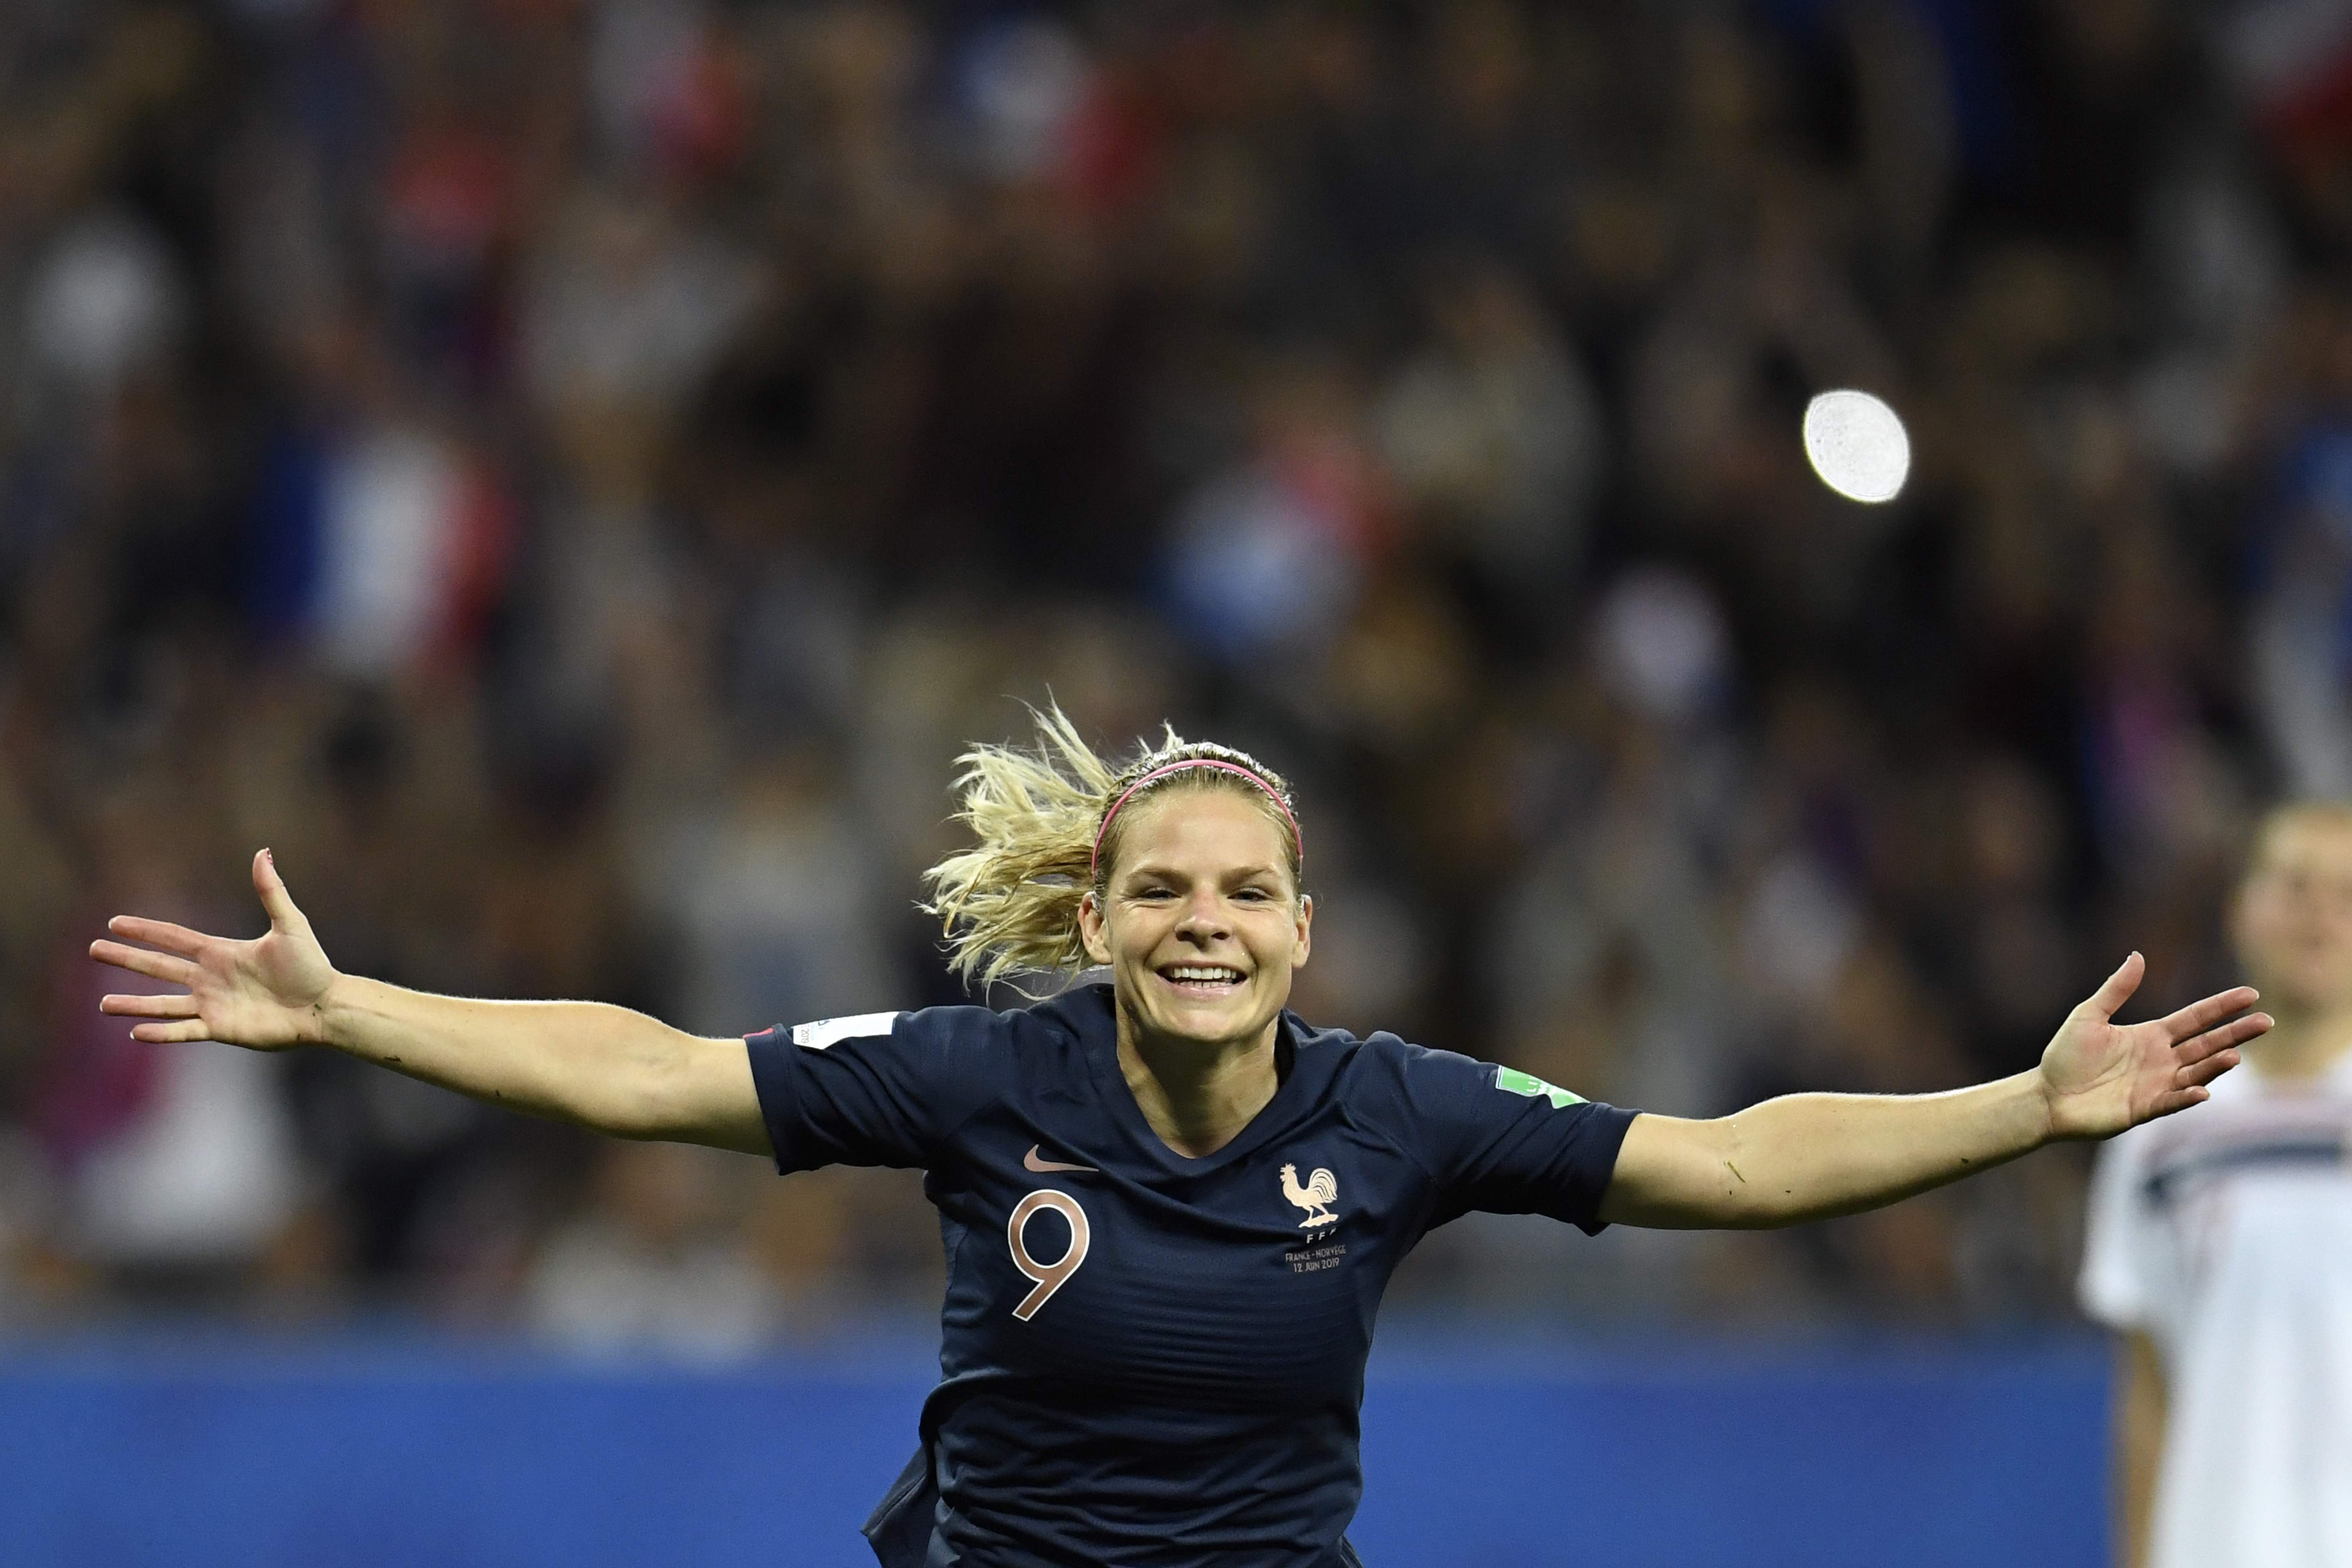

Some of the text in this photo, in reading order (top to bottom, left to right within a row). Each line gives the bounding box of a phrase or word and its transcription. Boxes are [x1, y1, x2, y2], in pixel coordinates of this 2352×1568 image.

[1007, 1189, 1090, 1322] 9
[1293, 1258, 1339, 1273] 12 JUIN 2019
